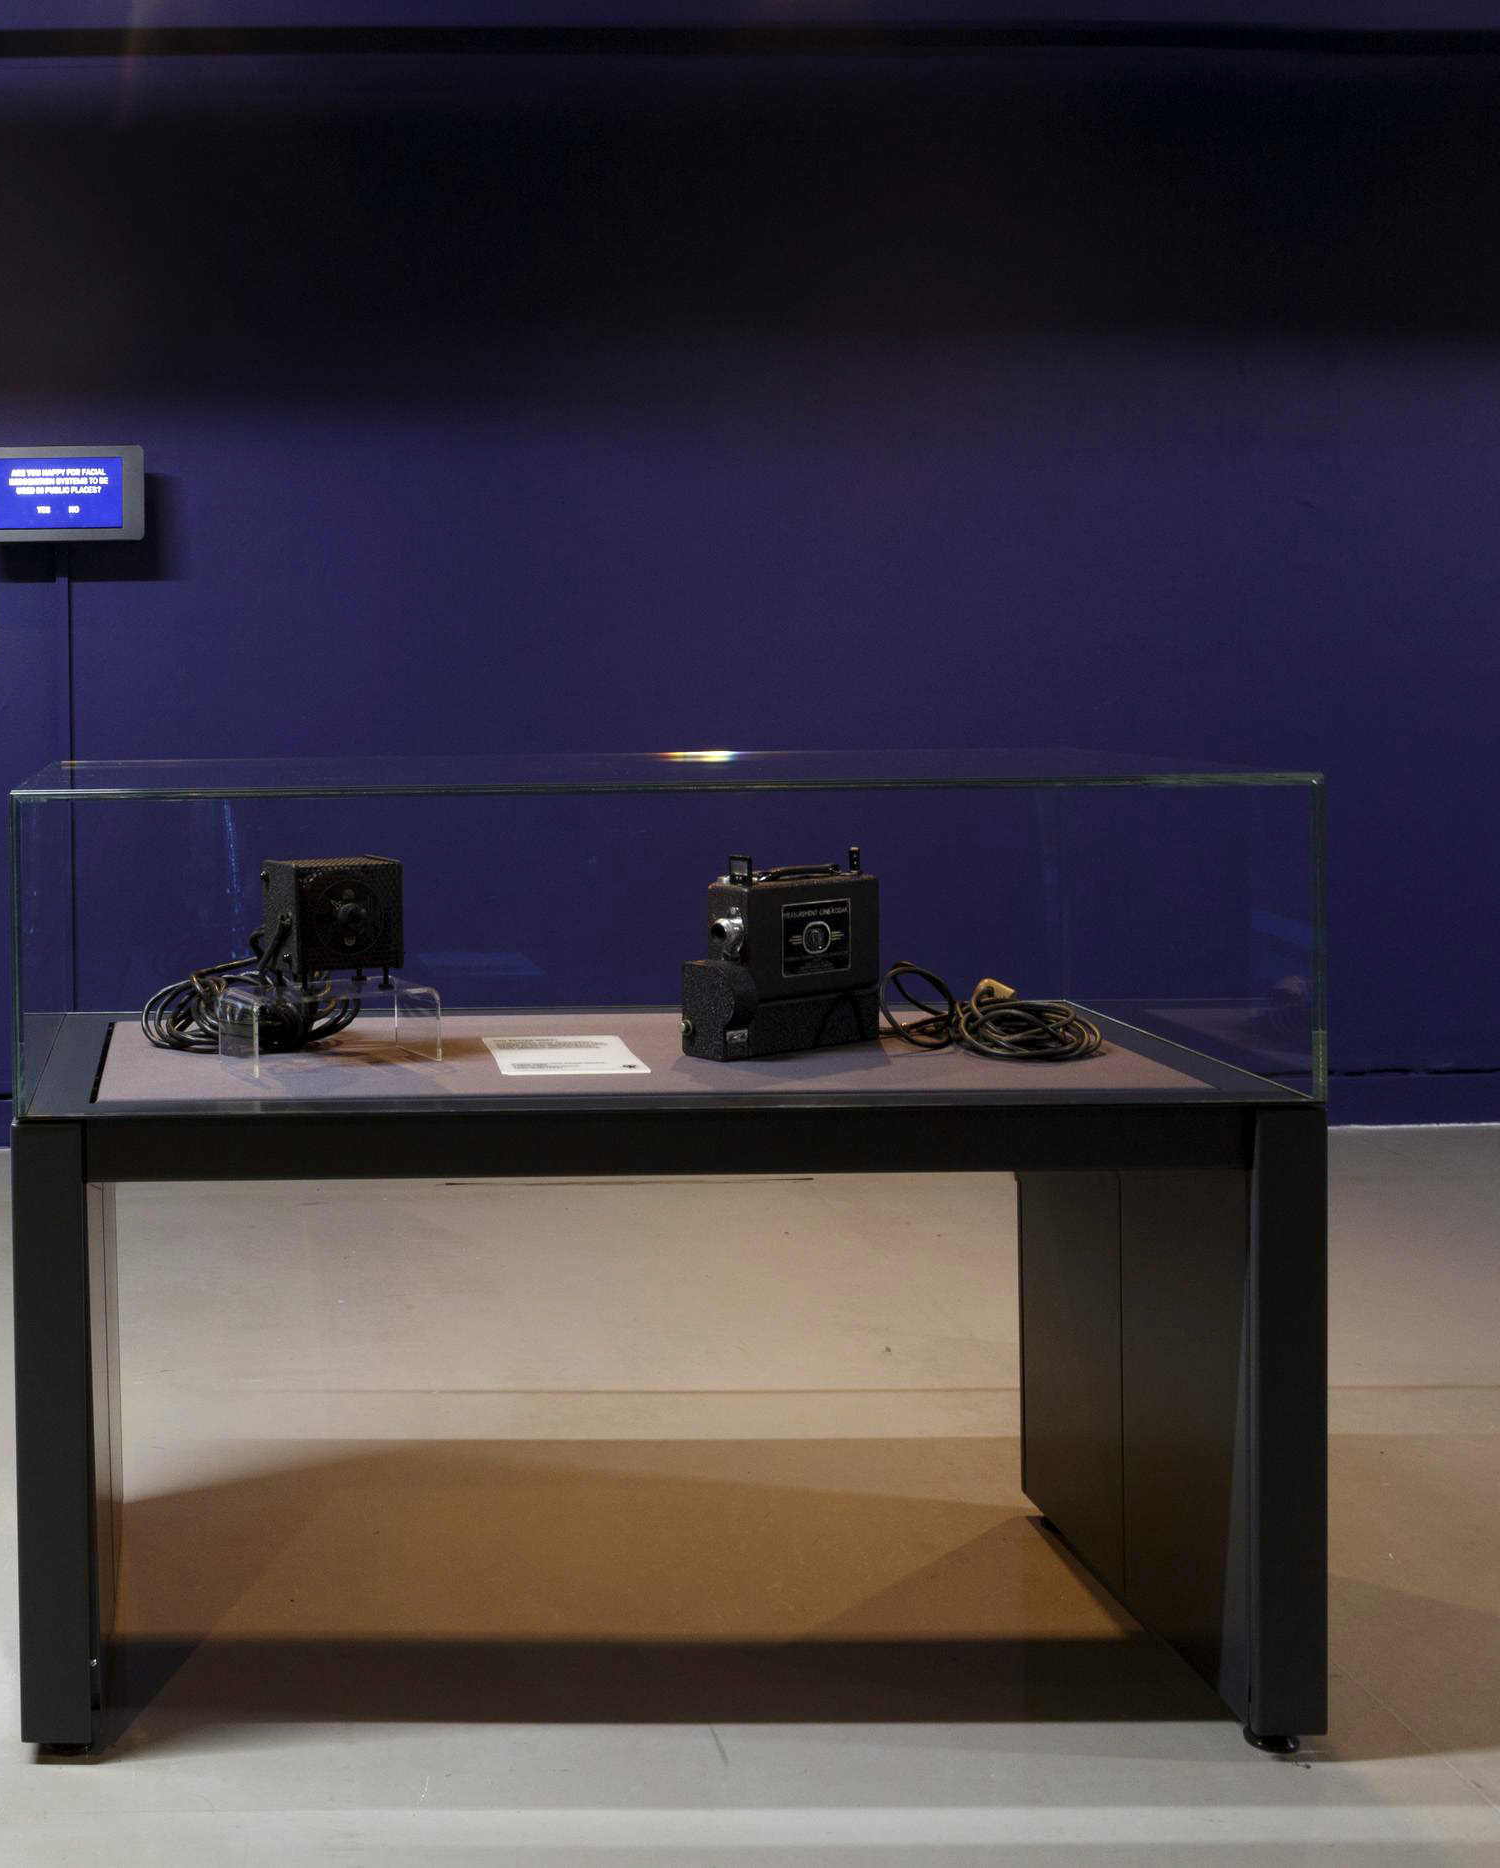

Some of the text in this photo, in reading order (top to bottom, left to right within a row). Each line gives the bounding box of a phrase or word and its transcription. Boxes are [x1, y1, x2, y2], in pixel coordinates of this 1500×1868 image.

[66, 468, 81, 476] FOR
[82, 468, 106, 476] FACIAL
[56, 477, 88, 485] SYSTEMS
[71, 486, 102, 494] PLACES?
[36, 505, 80, 514] YES NO
